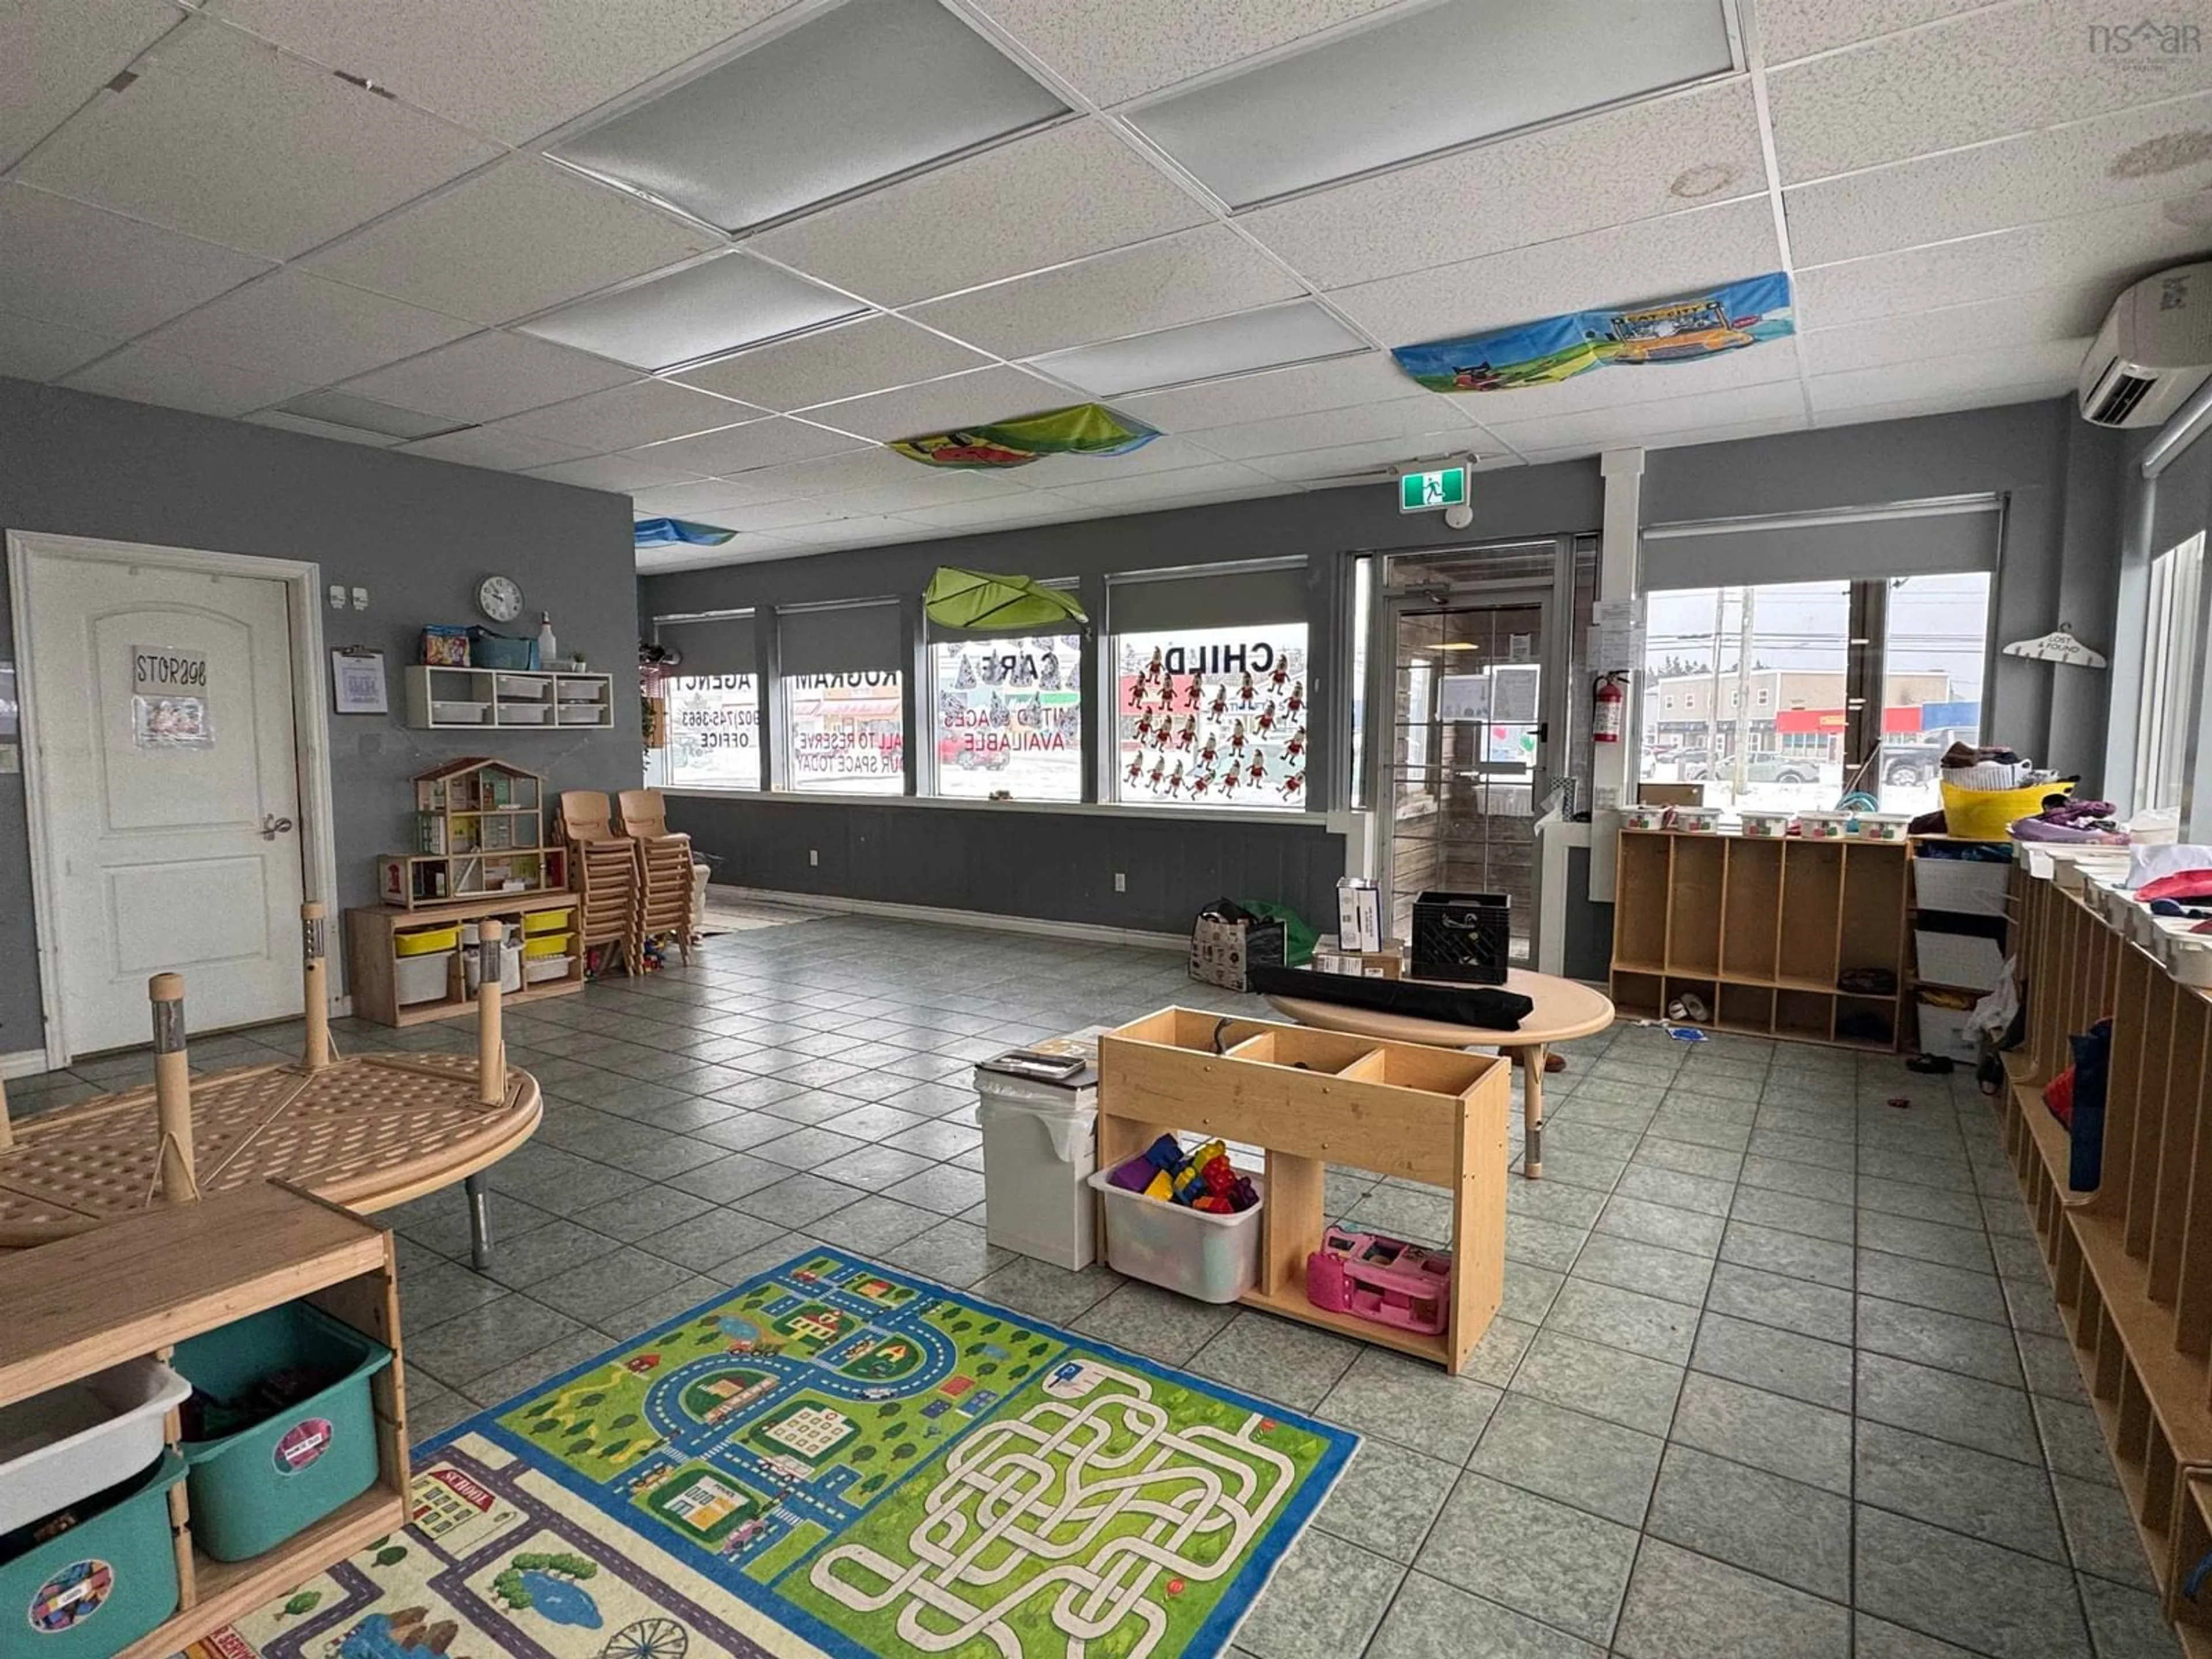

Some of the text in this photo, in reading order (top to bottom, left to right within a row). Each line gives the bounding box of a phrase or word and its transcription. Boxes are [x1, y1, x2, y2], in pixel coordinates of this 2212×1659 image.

[2048, 636, 2071, 644] LOST
[2046, 643, 2080, 653] FOUND
[440, 1470, 490, 1506] SCHOOL
